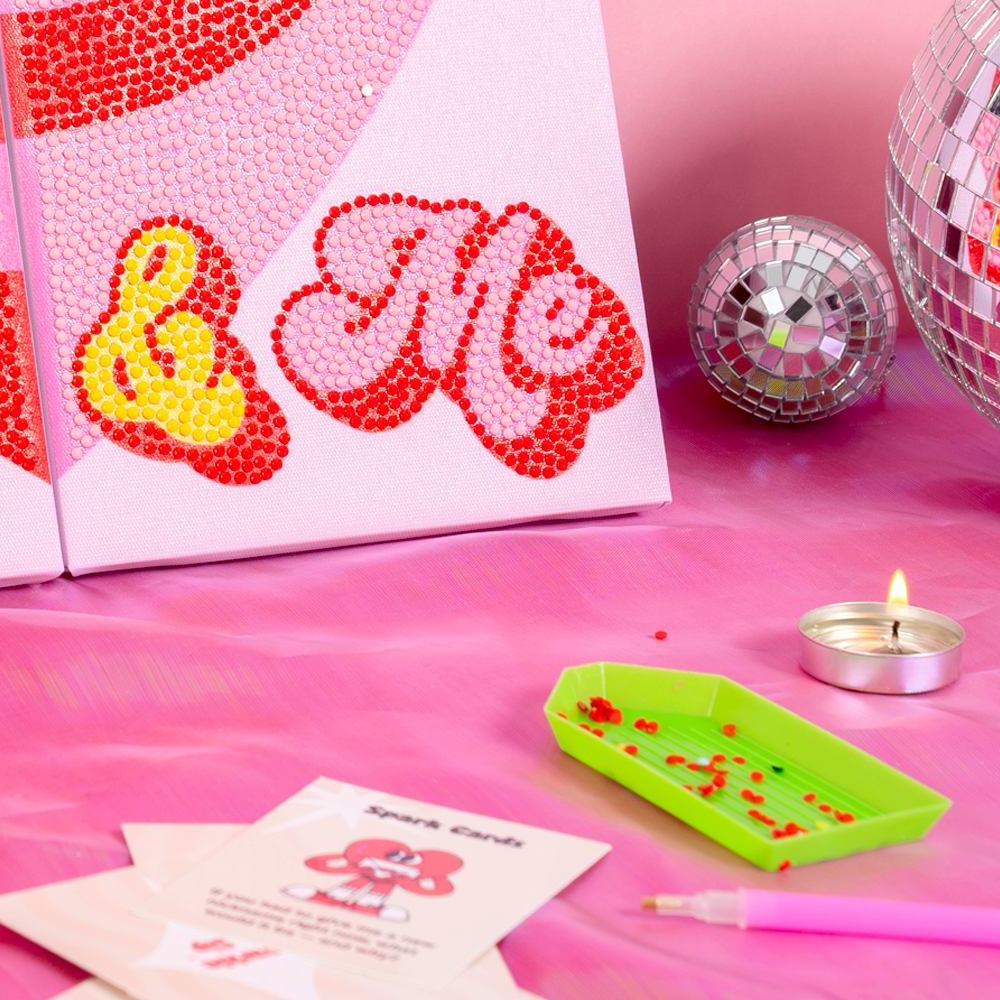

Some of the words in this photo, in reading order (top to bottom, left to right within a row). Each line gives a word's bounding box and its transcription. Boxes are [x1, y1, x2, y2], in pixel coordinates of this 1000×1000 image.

[272, 193, 618, 448] Me
[364, 805, 442, 831] Spark
[450, 826, 526, 849] Cards
